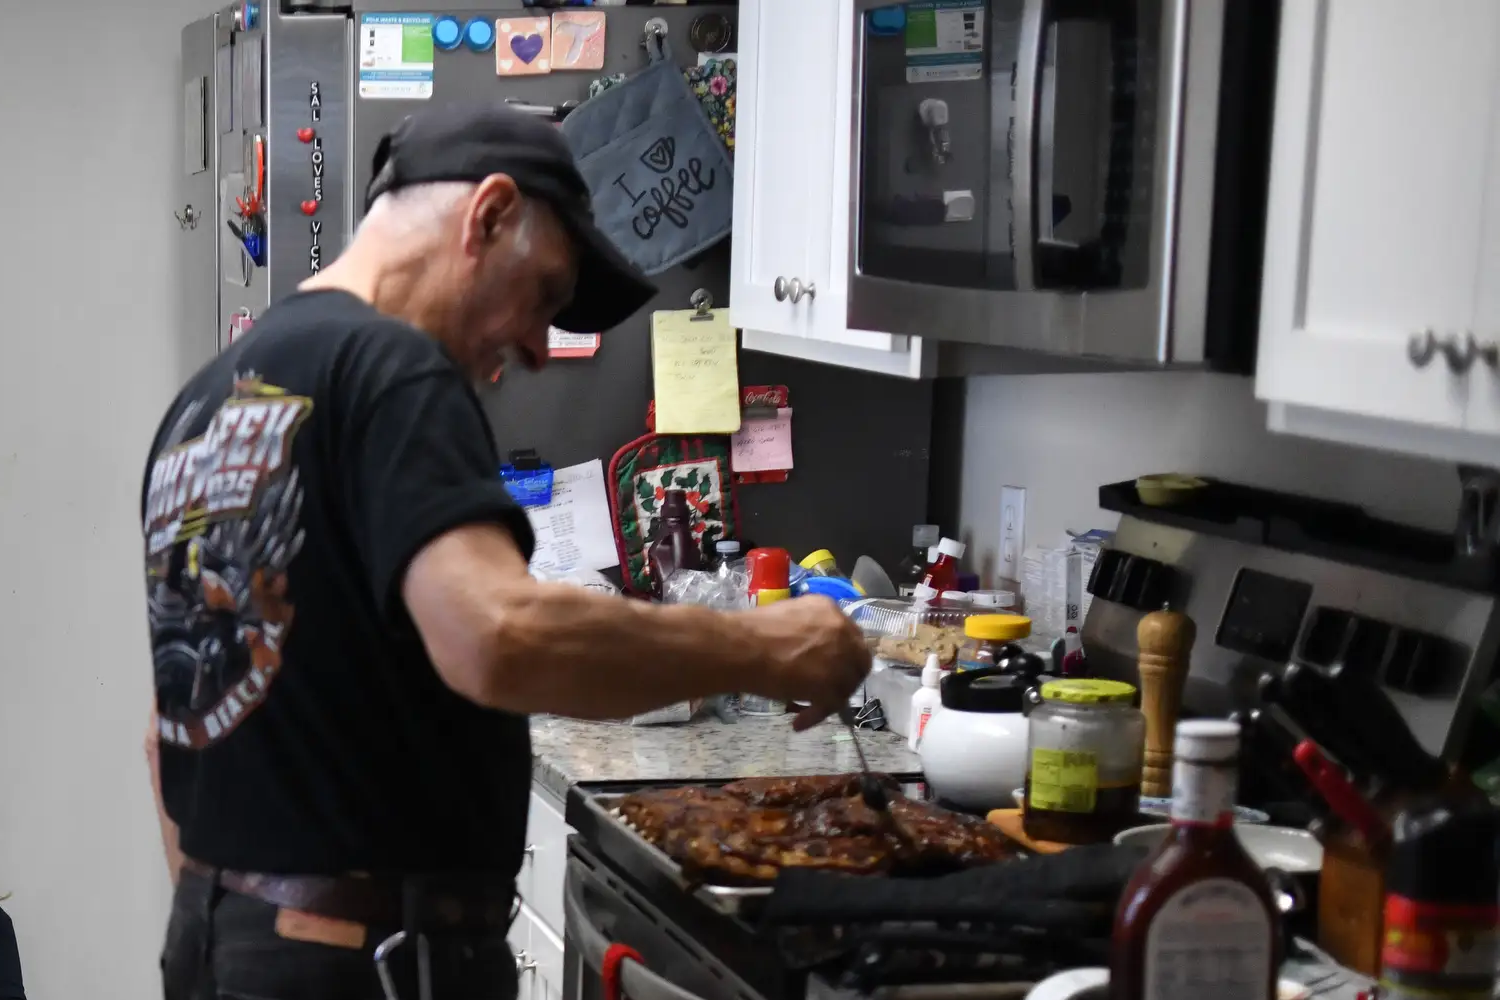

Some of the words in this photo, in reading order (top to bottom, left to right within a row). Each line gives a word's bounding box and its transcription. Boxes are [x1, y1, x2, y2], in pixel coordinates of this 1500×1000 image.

[310, 81, 321, 122] SAL
[311, 138, 323, 201] LOVES
[612, 172, 647, 208] I
[632, 157, 715, 240] coffee
